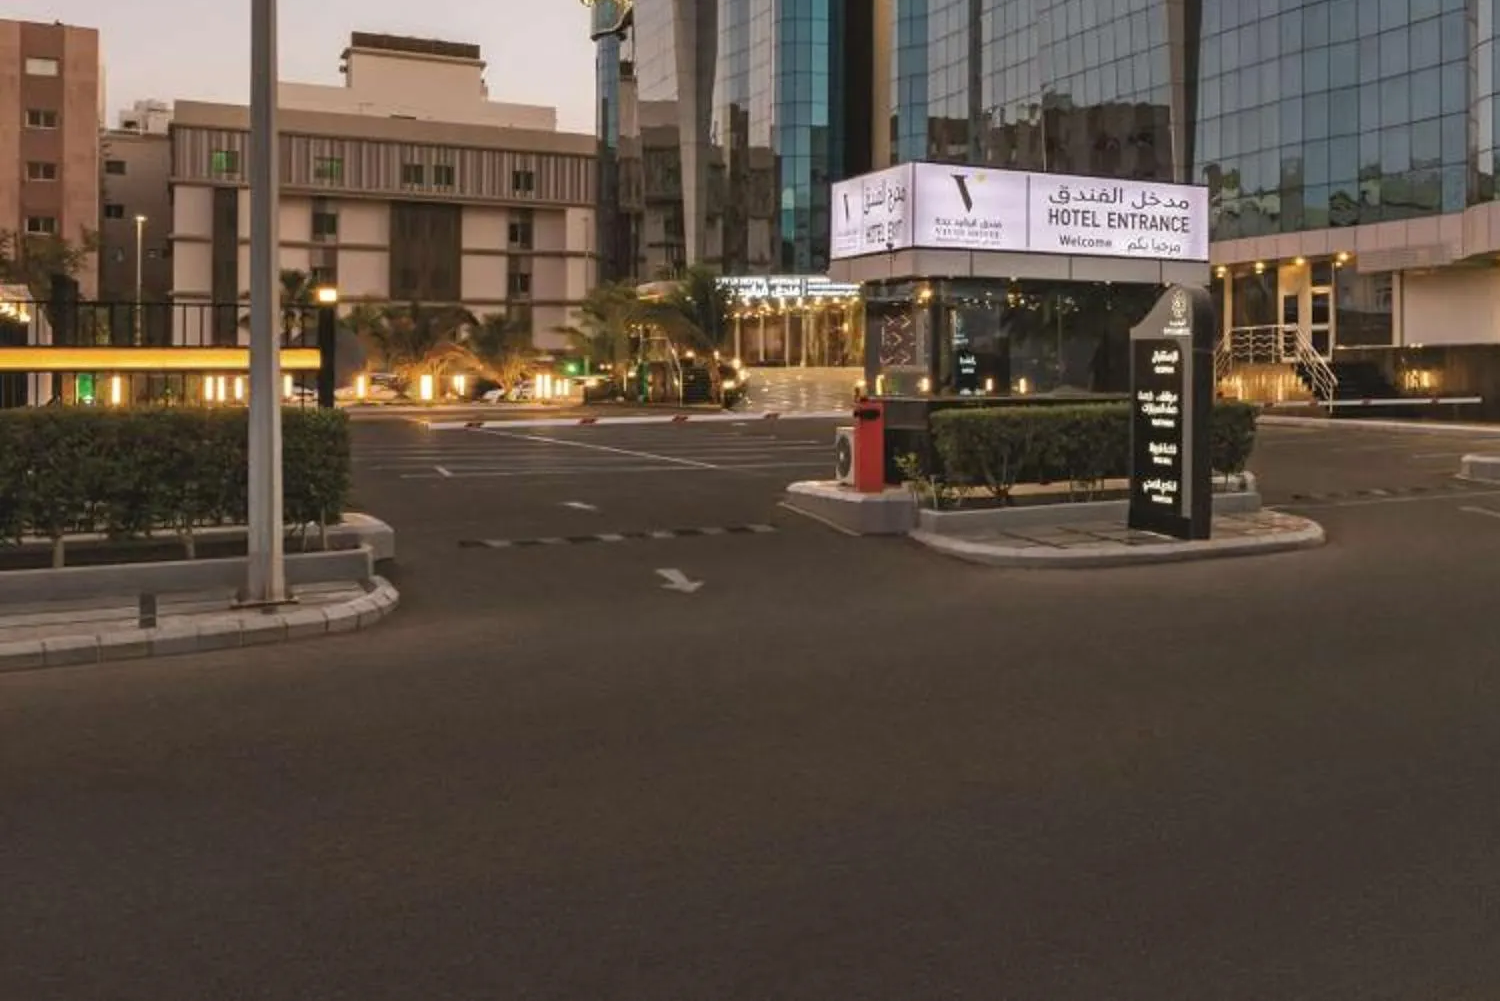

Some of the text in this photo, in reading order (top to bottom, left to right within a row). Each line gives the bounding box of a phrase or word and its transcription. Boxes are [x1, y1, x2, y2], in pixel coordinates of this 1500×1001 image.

[1049, 185, 1190, 210] مدخل الفندق
[1049, 208, 1191, 233] HOTEL ENTRANCE
[1059, 234, 1112, 248] Welcome
